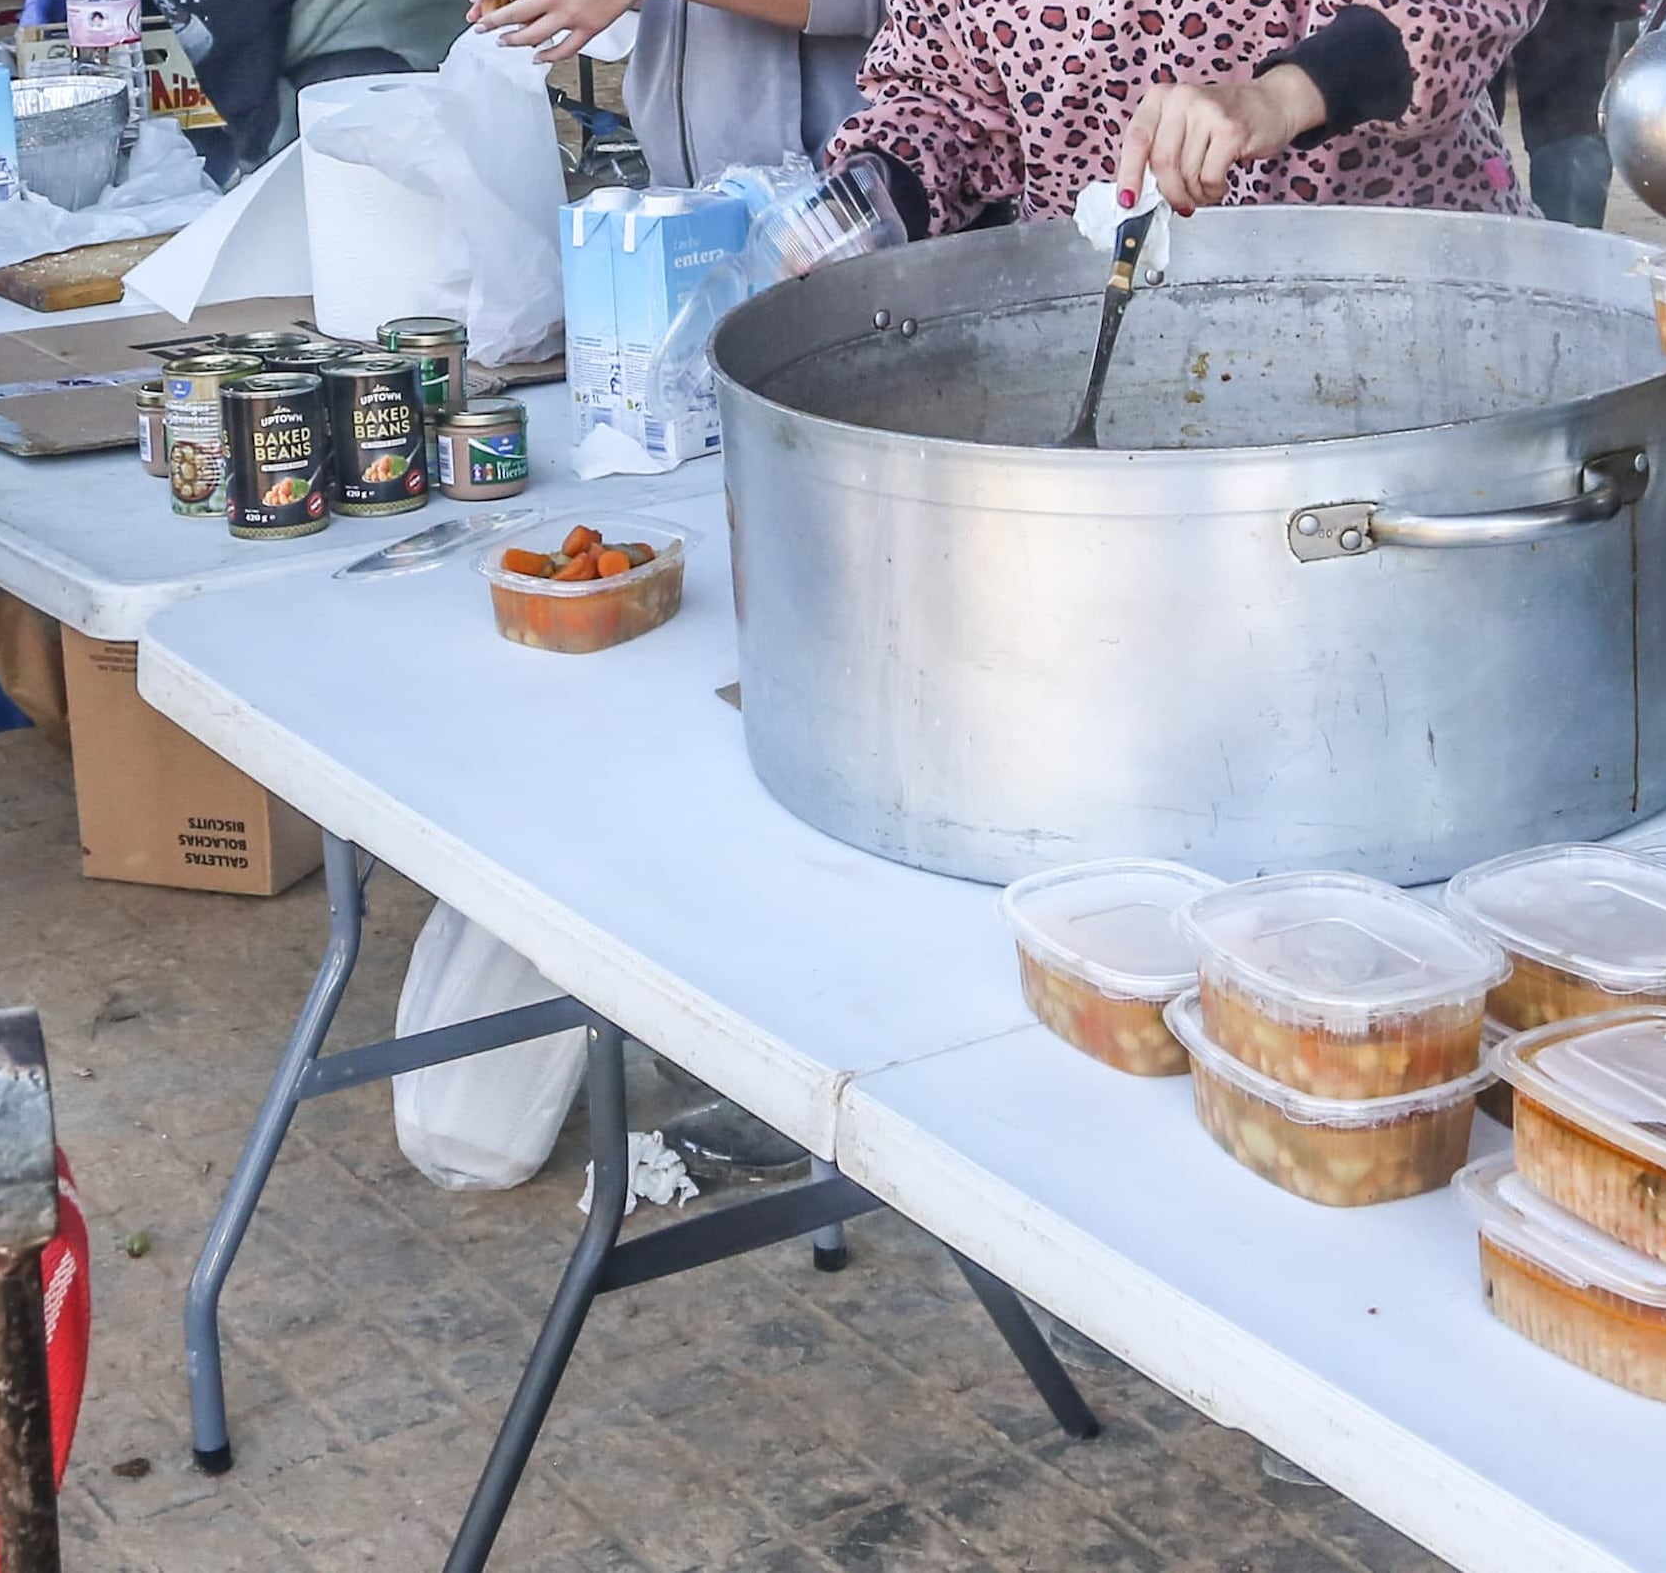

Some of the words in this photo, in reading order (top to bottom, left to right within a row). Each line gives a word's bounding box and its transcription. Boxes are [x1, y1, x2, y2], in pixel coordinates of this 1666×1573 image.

[360, 392, 402, 406] UPTOWN
[260, 412, 303, 428] UPTOWN
[353, 406, 410, 426] BAKED
[253, 427, 312, 448] BAKED
[354, 420, 411, 439] BEANS
[254, 442, 312, 463] BEANS
[245, 513, 261, 522] 420
[187, 817, 245, 833] BISCUITS
[178, 834, 247, 851] BOLACHAS
[184, 853, 248, 869] GALLETAS
